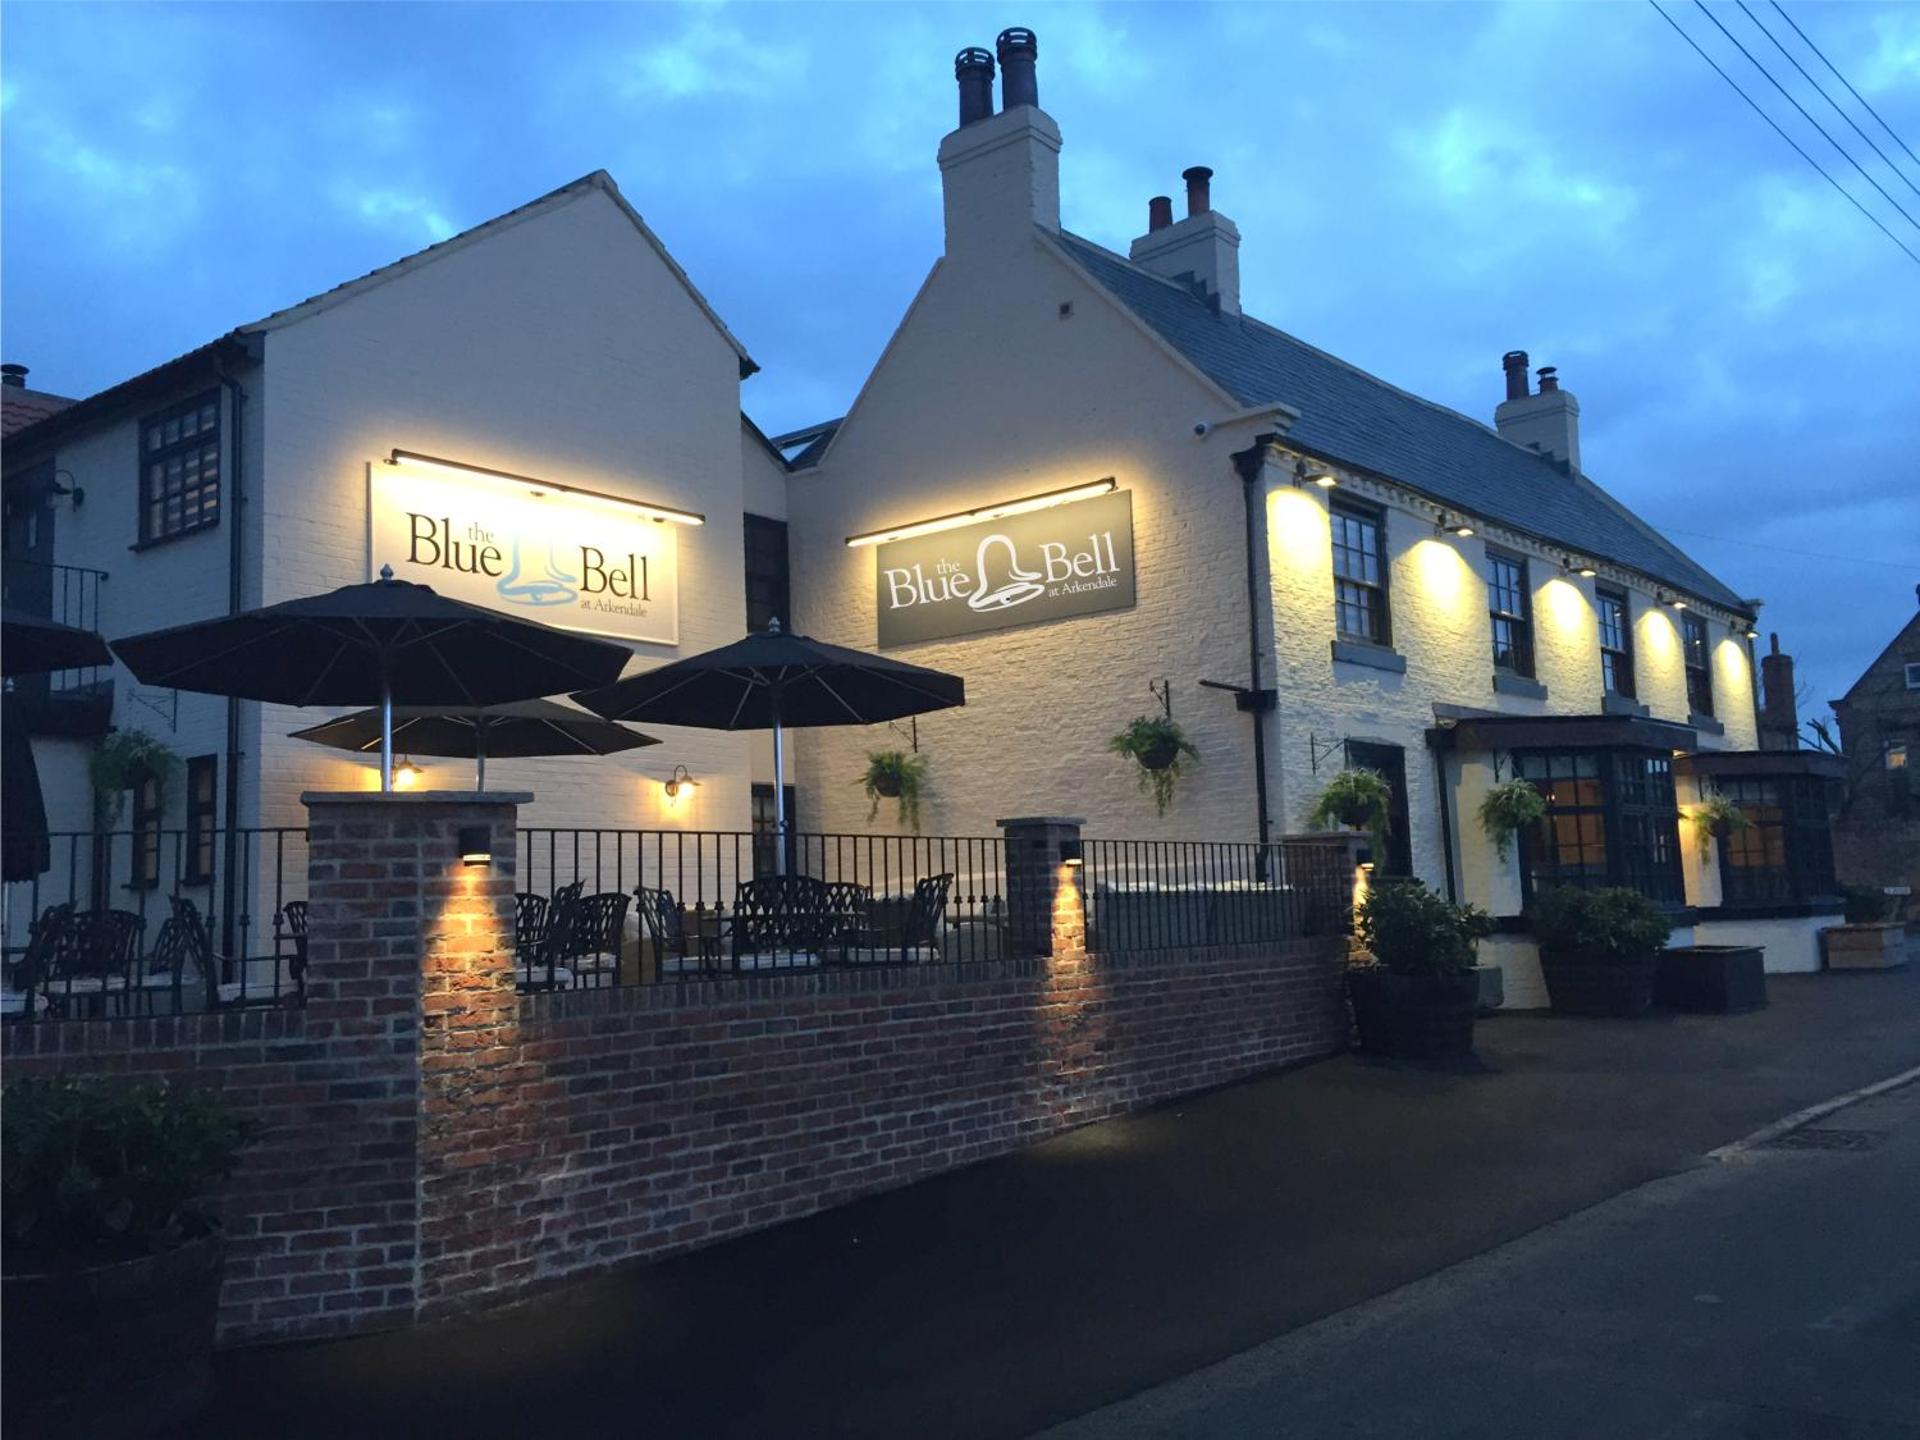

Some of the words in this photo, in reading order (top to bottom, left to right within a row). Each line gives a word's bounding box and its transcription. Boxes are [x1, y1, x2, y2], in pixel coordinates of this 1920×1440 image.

[468, 522, 495, 544] the
[405, 512, 503, 577] Blue
[580, 545, 652, 602] Bell
[936, 558, 961, 575] the
[884, 563, 972, 609] Blue
[1038, 531, 1121, 583] Bell
[1048, 587, 1059, 598] at
[1062, 575, 1118, 596] Arkendale
[580, 600, 591, 610] at
[593, 598, 648, 617] Arkendale
